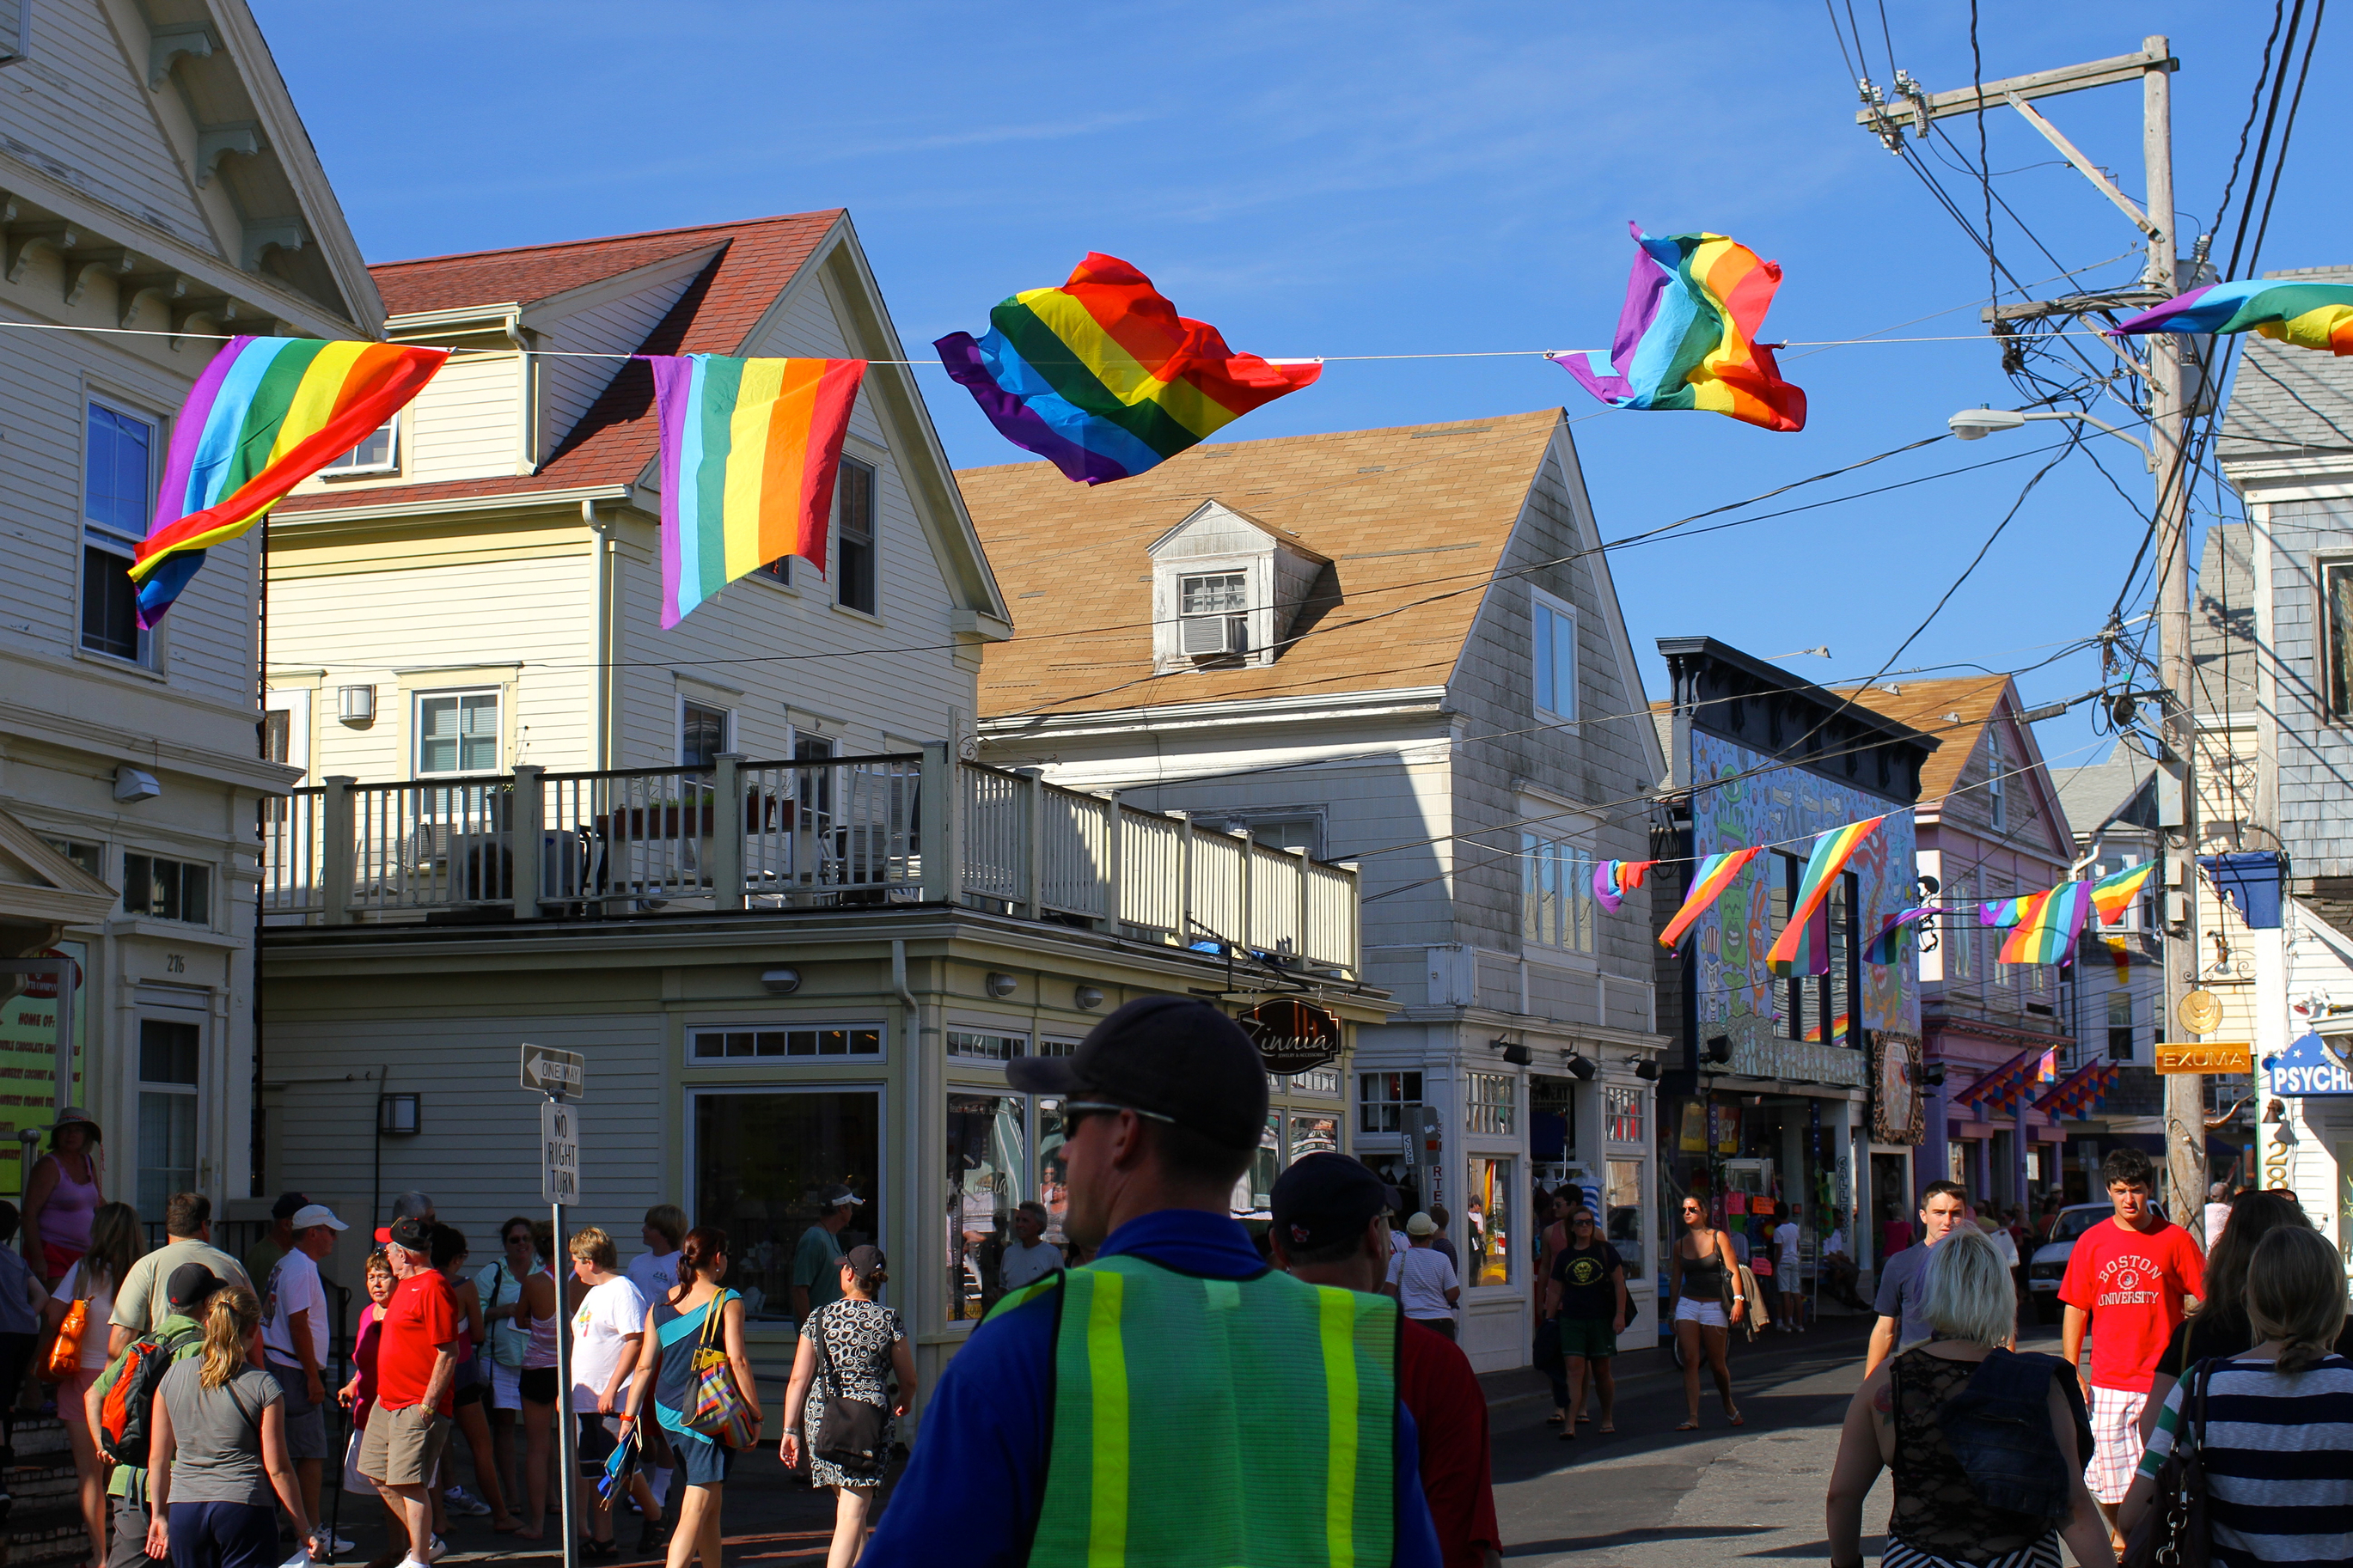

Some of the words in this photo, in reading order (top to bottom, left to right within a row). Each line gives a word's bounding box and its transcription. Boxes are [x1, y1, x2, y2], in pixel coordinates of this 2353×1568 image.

[168, 954, 185, 973] 276
[18, 1012, 41, 1027] HOME
[43, 1015, 55, 1028] OF:
[0, 1040, 15, 1051] OUBLE
[15, 1040, 44, 1053] CHOCOLATE
[1242, 1016, 1334, 1057] Zinnia
[2163, 1051, 2246, 1067] EXUMA
[542, 1062, 560, 1079] ONE
[564, 1065, 580, 1083] WAY
[1042, 1109, 1062, 1120] Cambridg
[554, 1114, 567, 1138] NO
[548, 1142, 576, 1168] RIGHT
[2265, 1141, 2289, 1190] 28
[551, 1169, 574, 1195] TURN
[2099, 1254, 2162, 1284] BOSTON
[2098, 1291, 2160, 1307] UNIVERSITY
